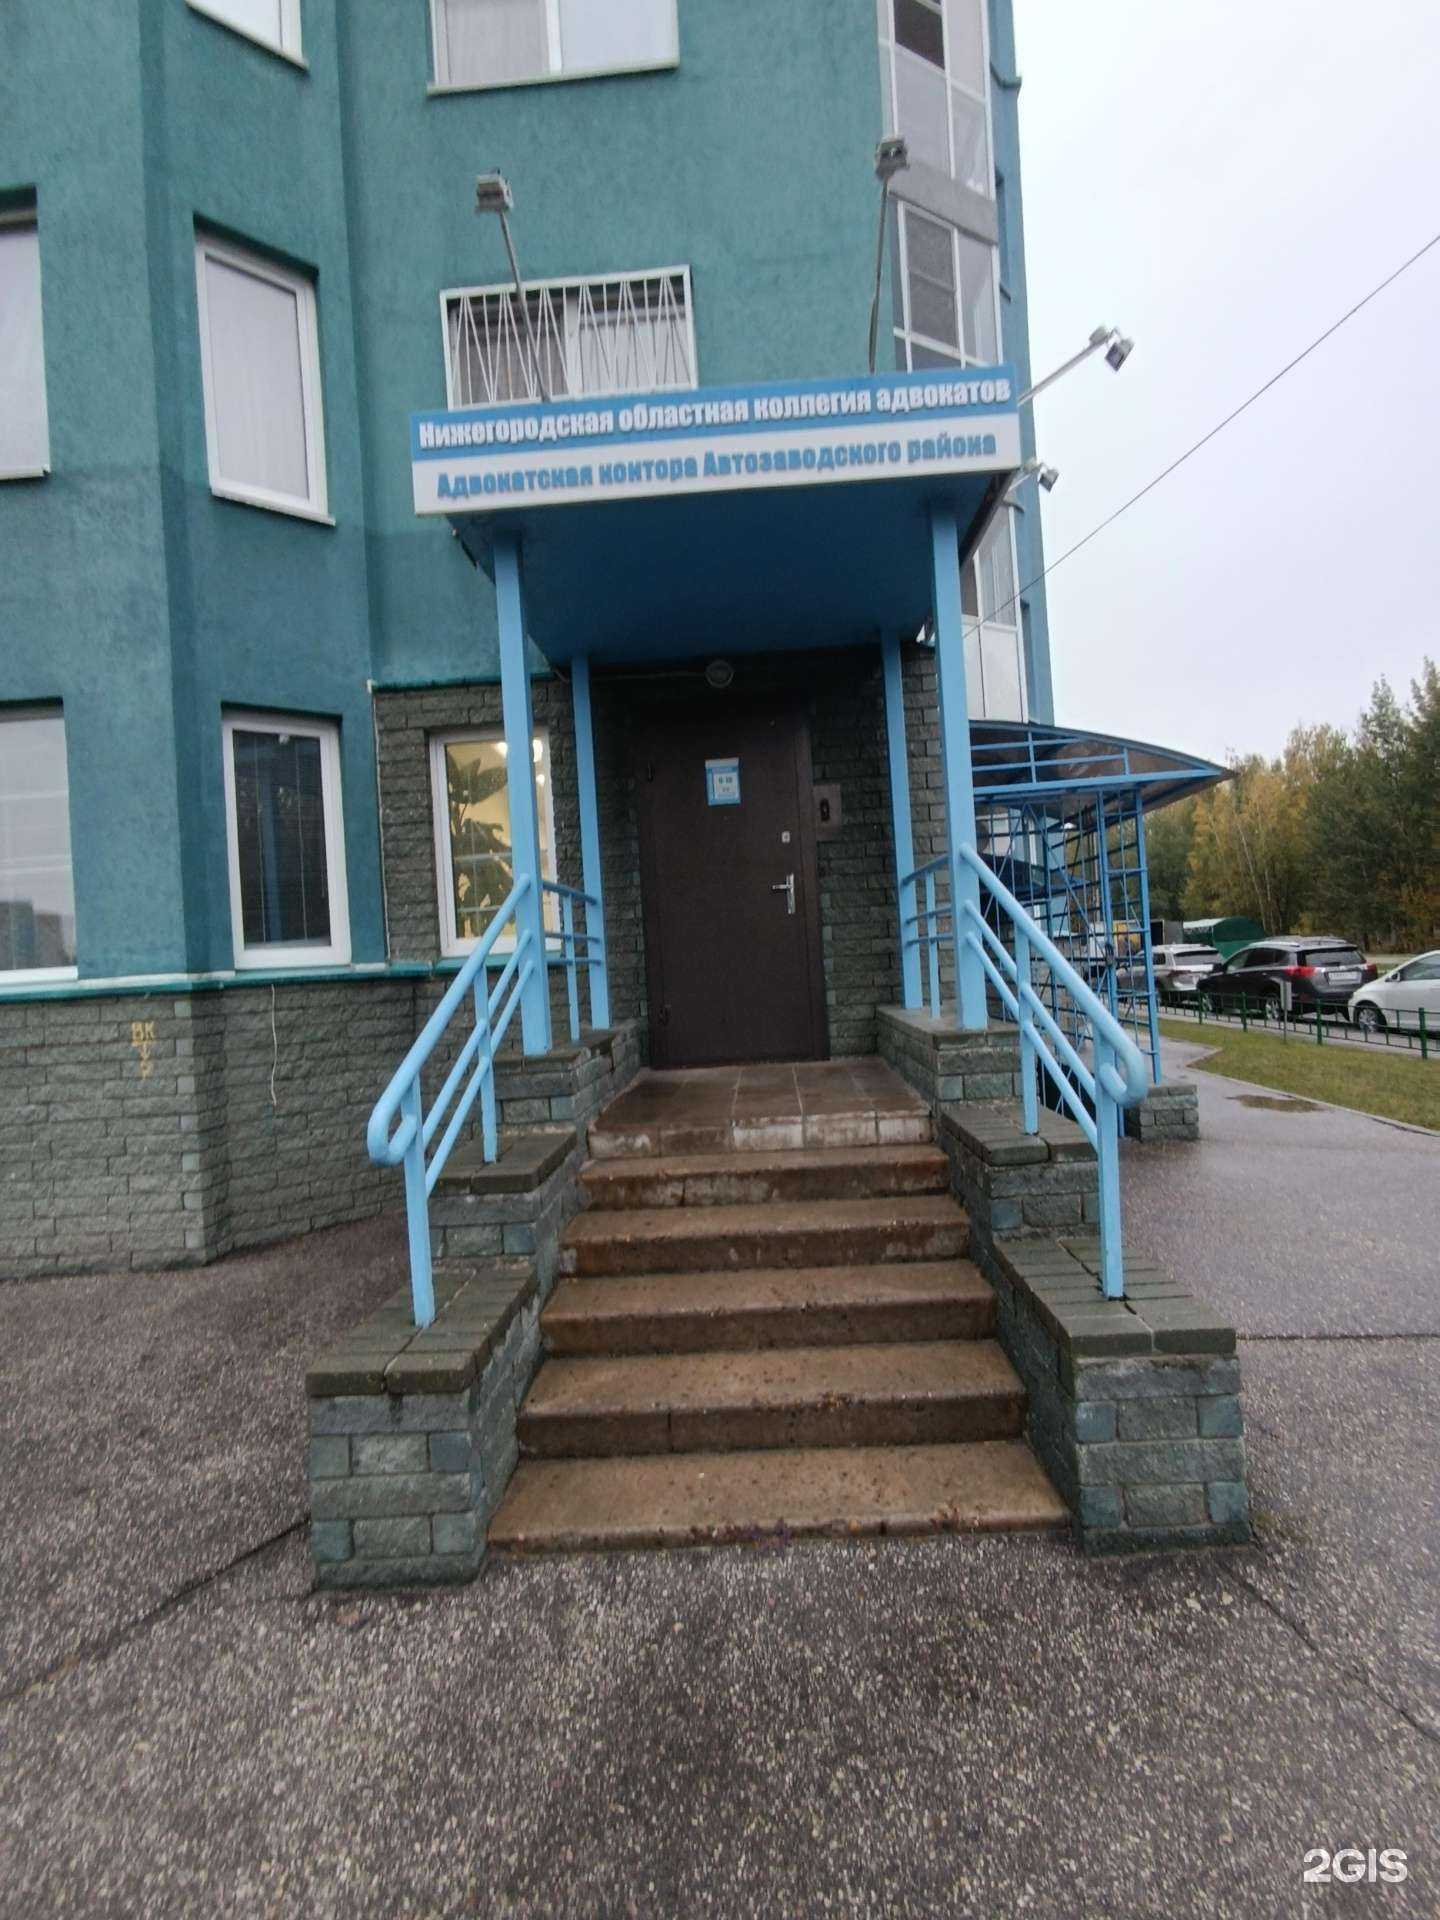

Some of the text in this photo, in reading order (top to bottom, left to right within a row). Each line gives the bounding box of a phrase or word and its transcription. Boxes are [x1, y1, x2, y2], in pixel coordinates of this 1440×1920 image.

[419, 378, 1011, 449] Нижегородская областная коллегия адвокатов
[437, 432, 997, 498] Адвокатская контора Автозаводского района
